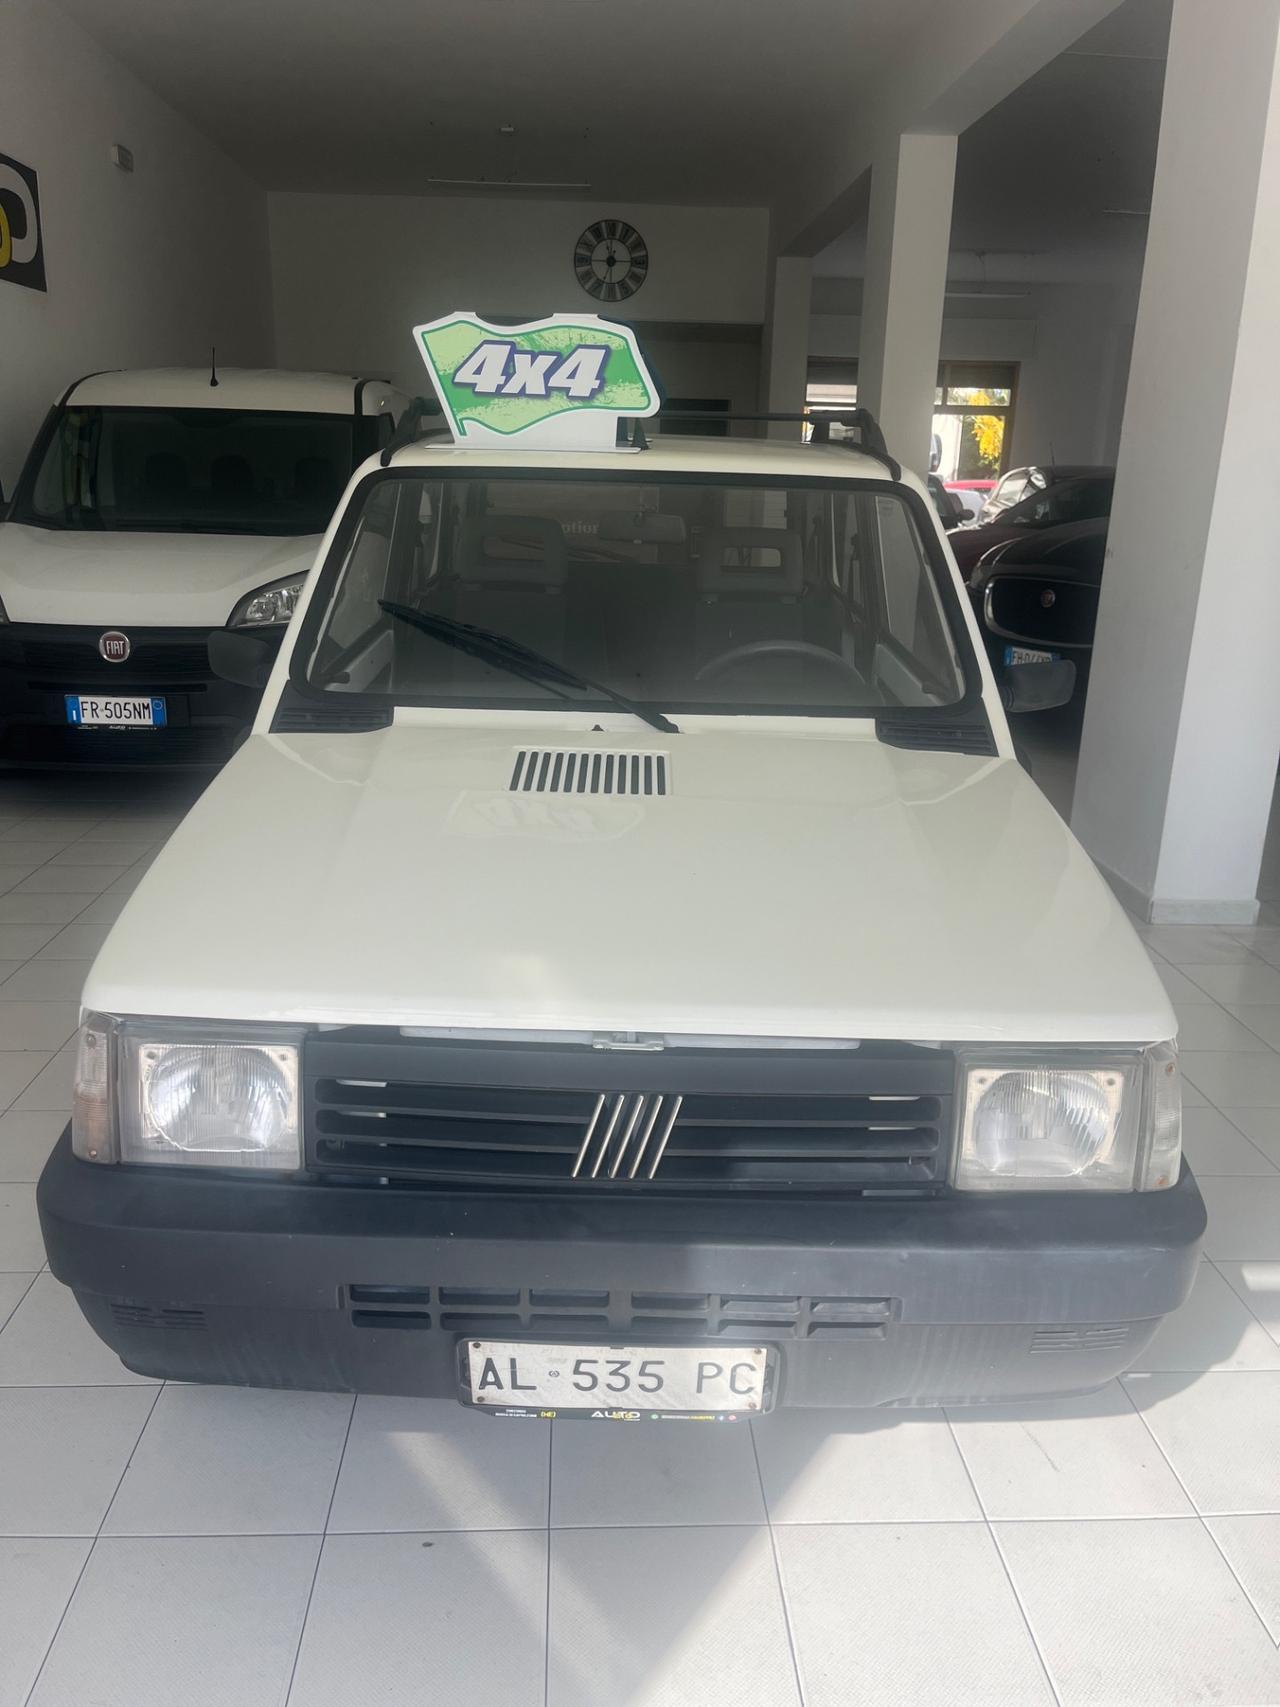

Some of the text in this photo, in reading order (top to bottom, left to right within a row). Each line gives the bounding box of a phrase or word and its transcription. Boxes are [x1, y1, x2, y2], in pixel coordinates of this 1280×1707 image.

[453, 342, 608, 398] 4x4
[106, 640, 125, 655] FIAT
[81, 701, 151, 720] FR 505NM
[478, 1357, 757, 1395] AL 535 PC
